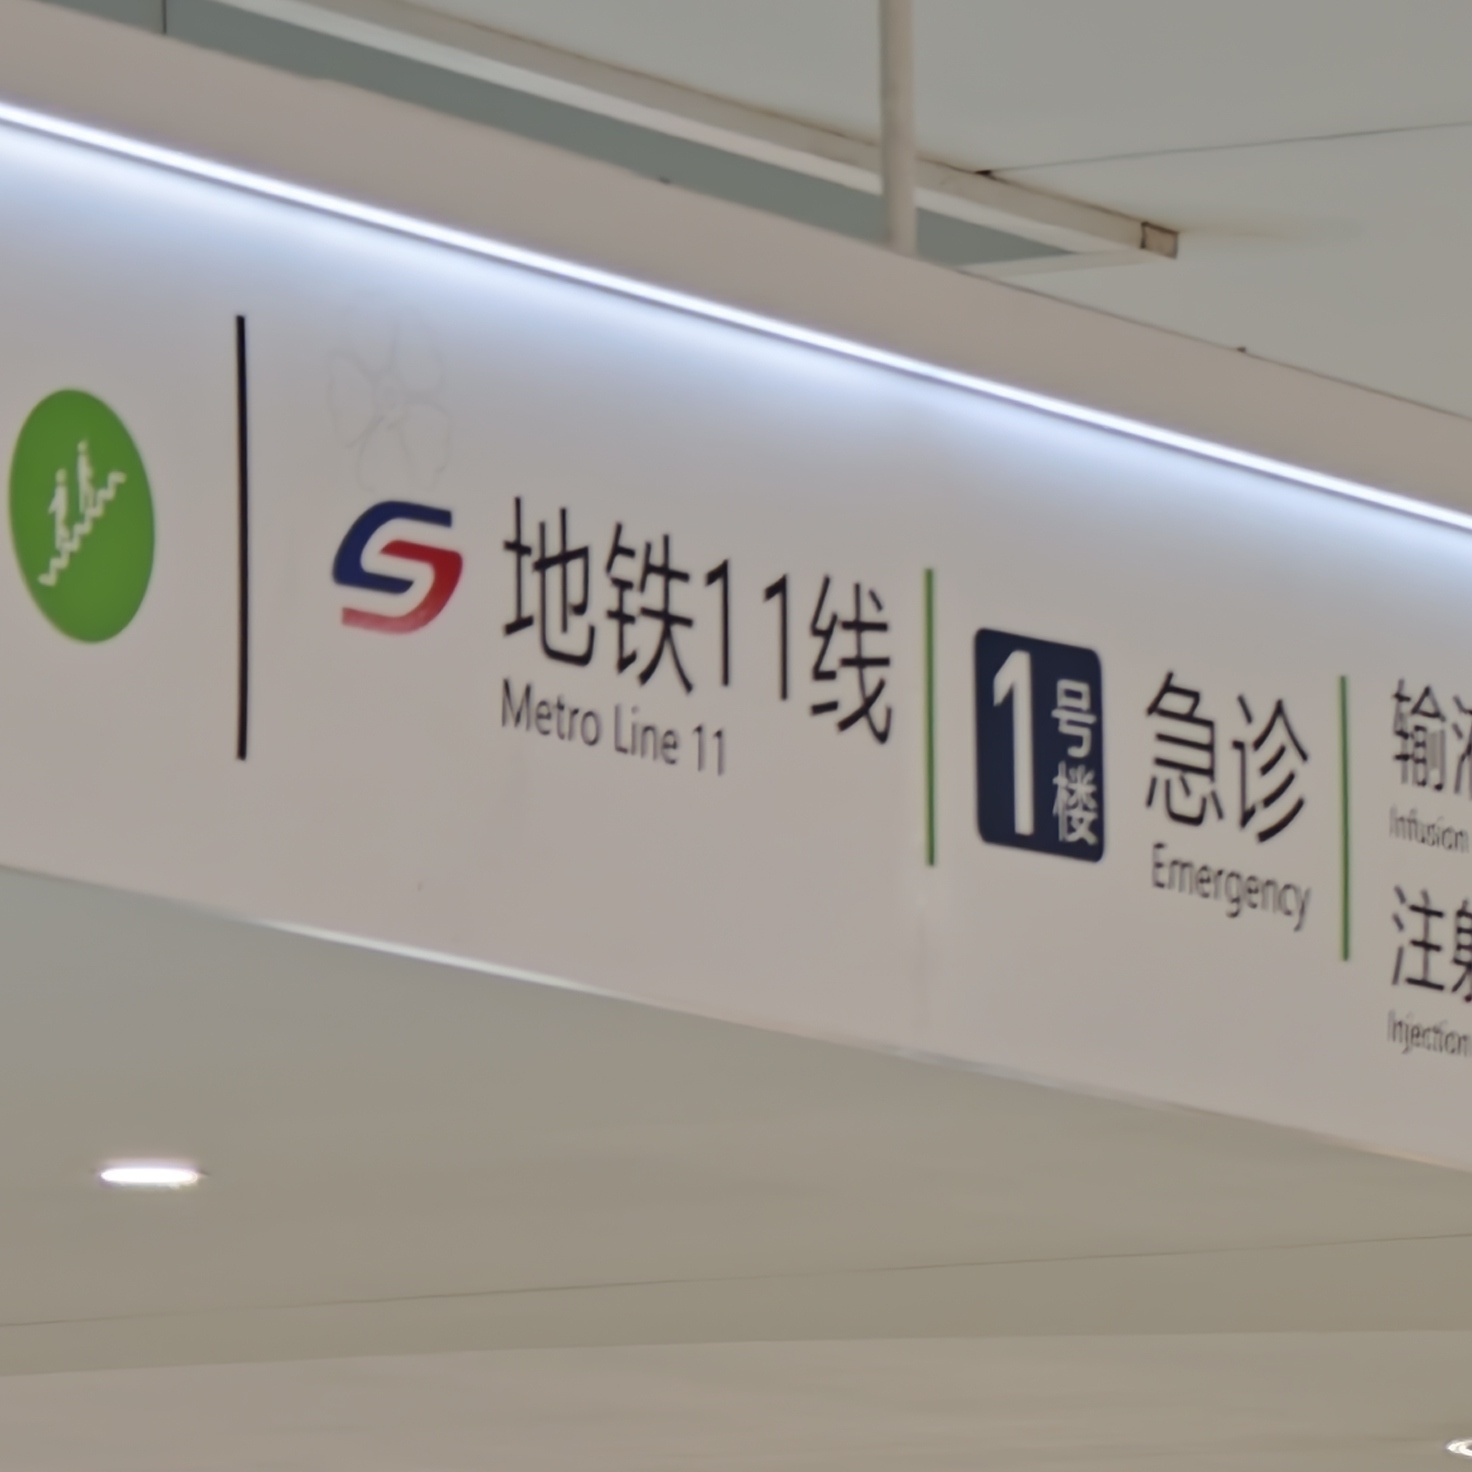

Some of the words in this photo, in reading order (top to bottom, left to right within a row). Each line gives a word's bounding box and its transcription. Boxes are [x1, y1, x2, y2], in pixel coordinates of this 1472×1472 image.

[502, 496, 893, 746] 地铁11线
[500, 678, 602, 748] Metro
[612, 703, 679, 767] Line
[691, 723, 728, 777] 11
[1145, 671, 1310, 844] 急诊
[1388, 804, 1471, 856] Infusion
[1151, 842, 1311, 932] Emergency
[1387, 1010, 1472, 1059] Injection
